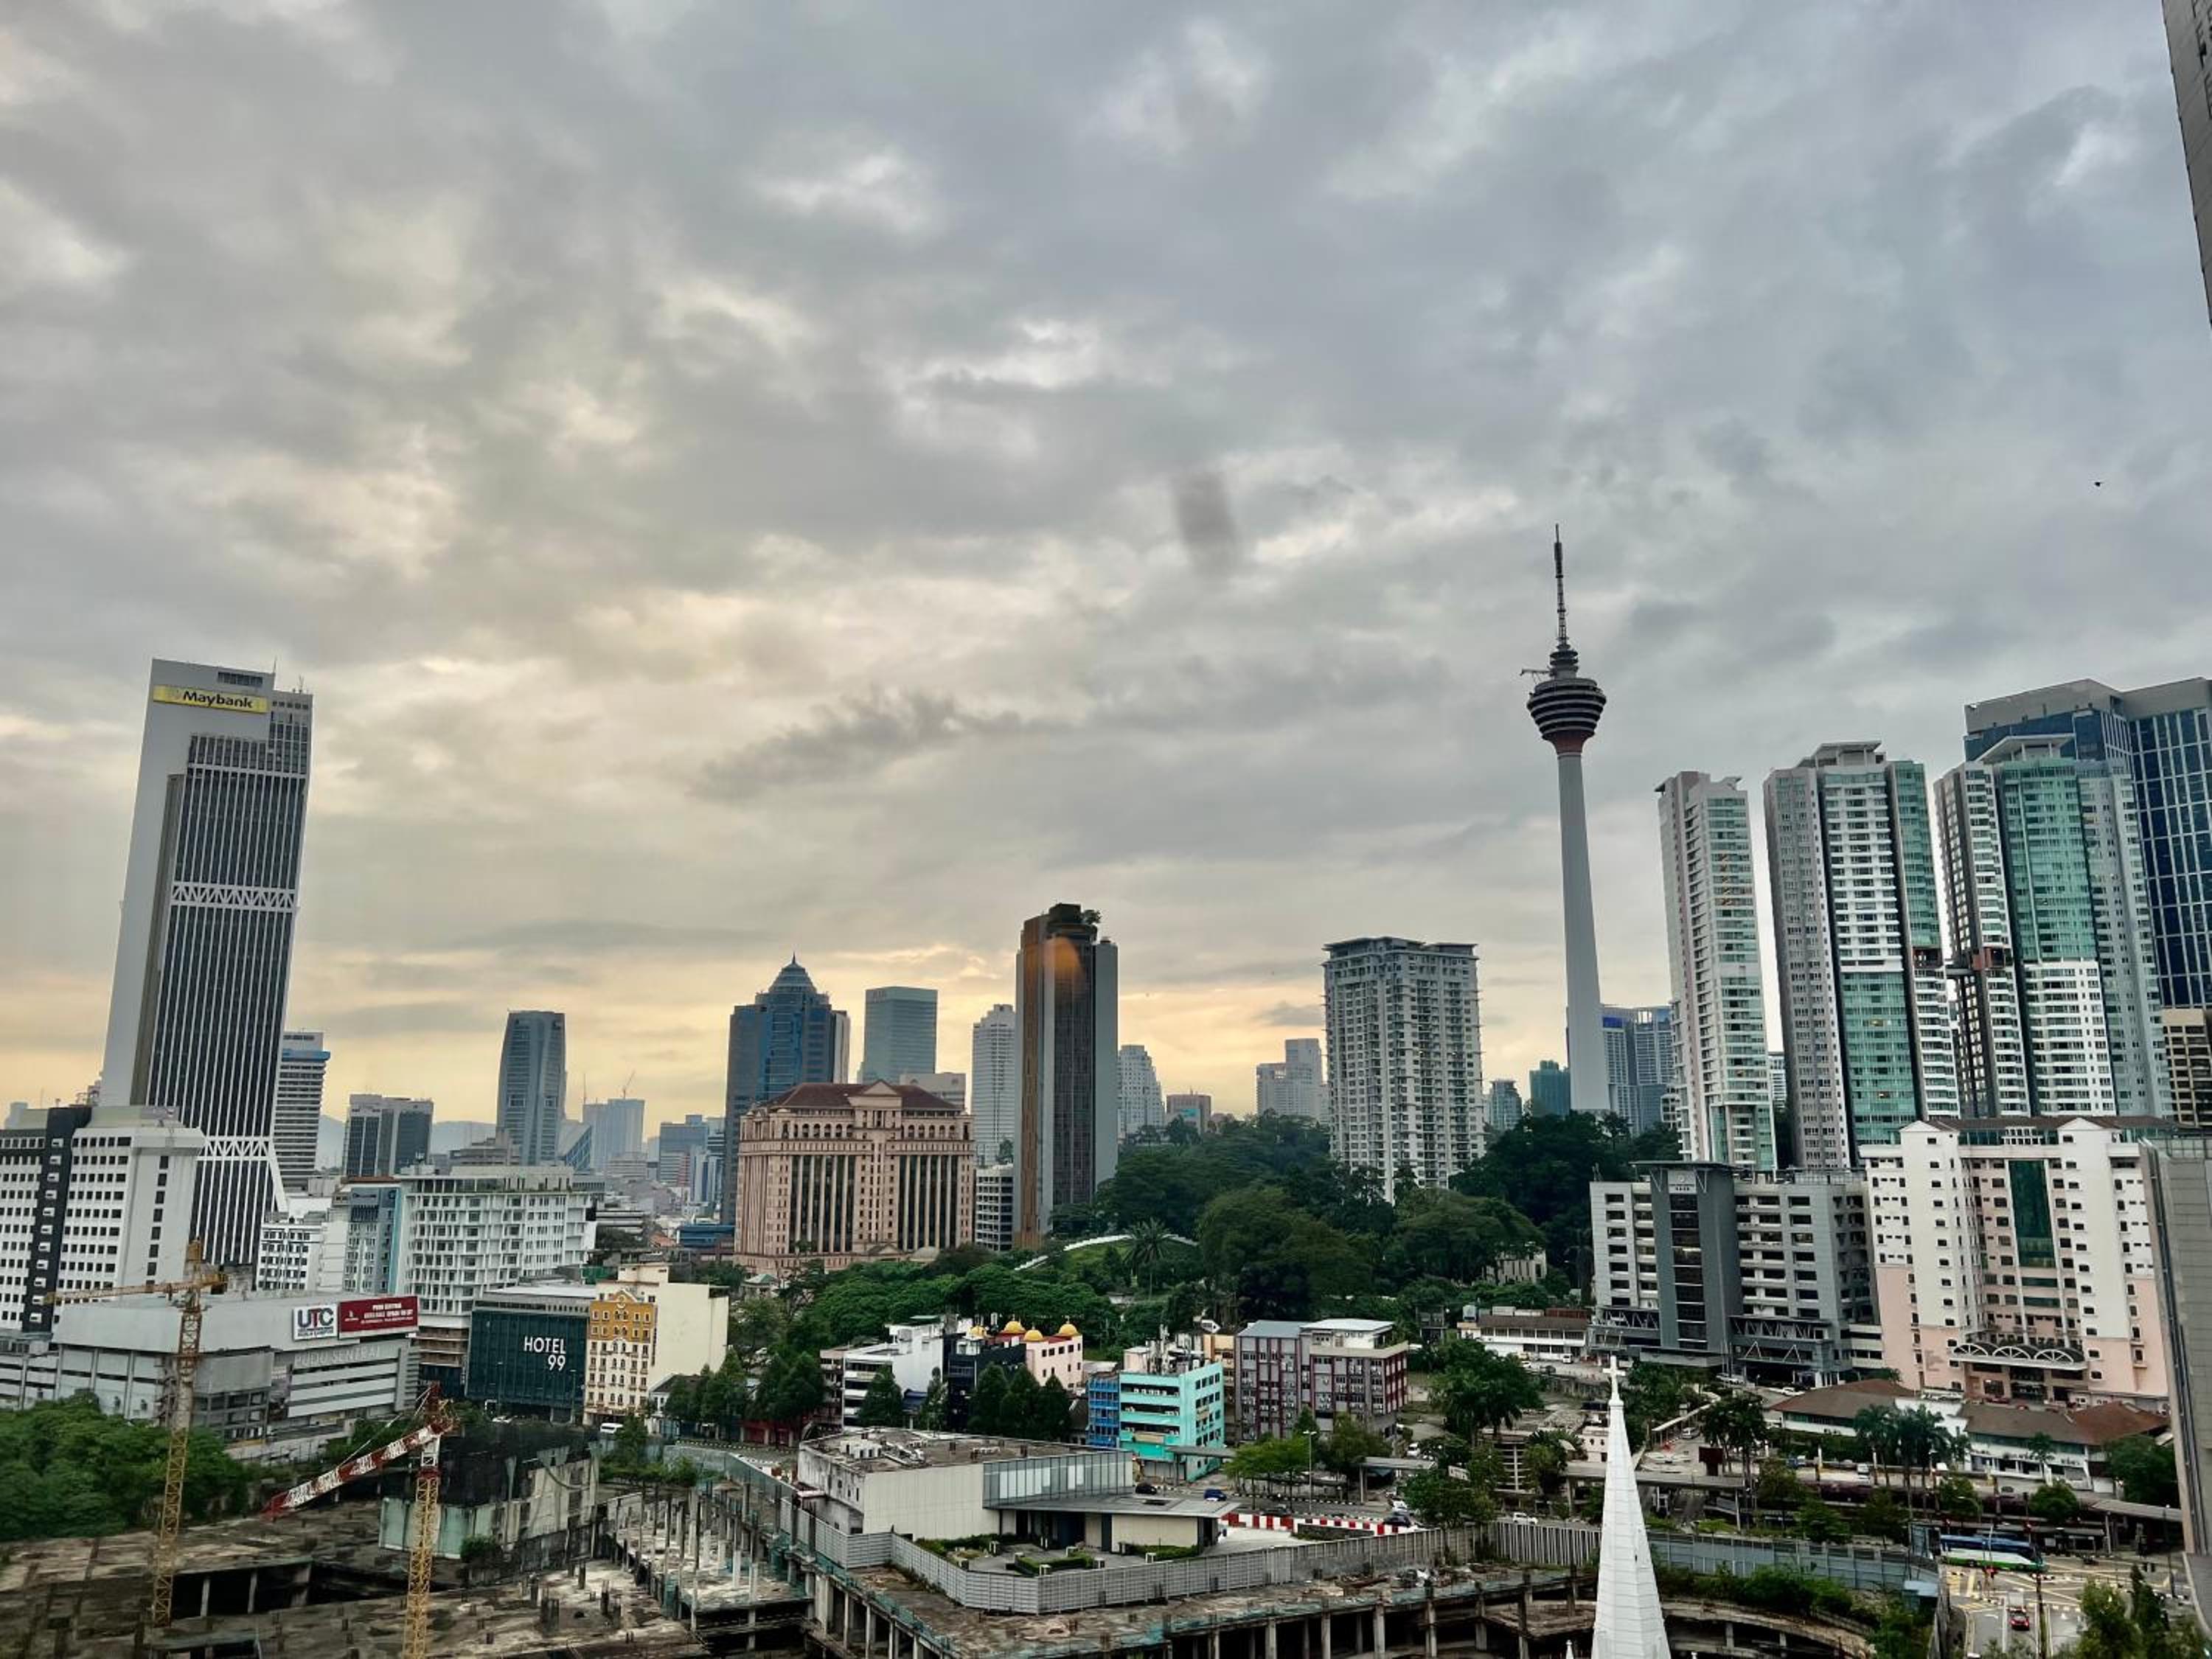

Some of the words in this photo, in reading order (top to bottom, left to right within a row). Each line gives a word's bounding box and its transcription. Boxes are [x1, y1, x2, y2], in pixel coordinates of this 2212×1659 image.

[184, 691, 253, 708] Maybank
[298, 1308, 333, 1328] UTC
[524, 1336, 566, 1354] HOTEL
[548, 1354, 566, 1371] 99
